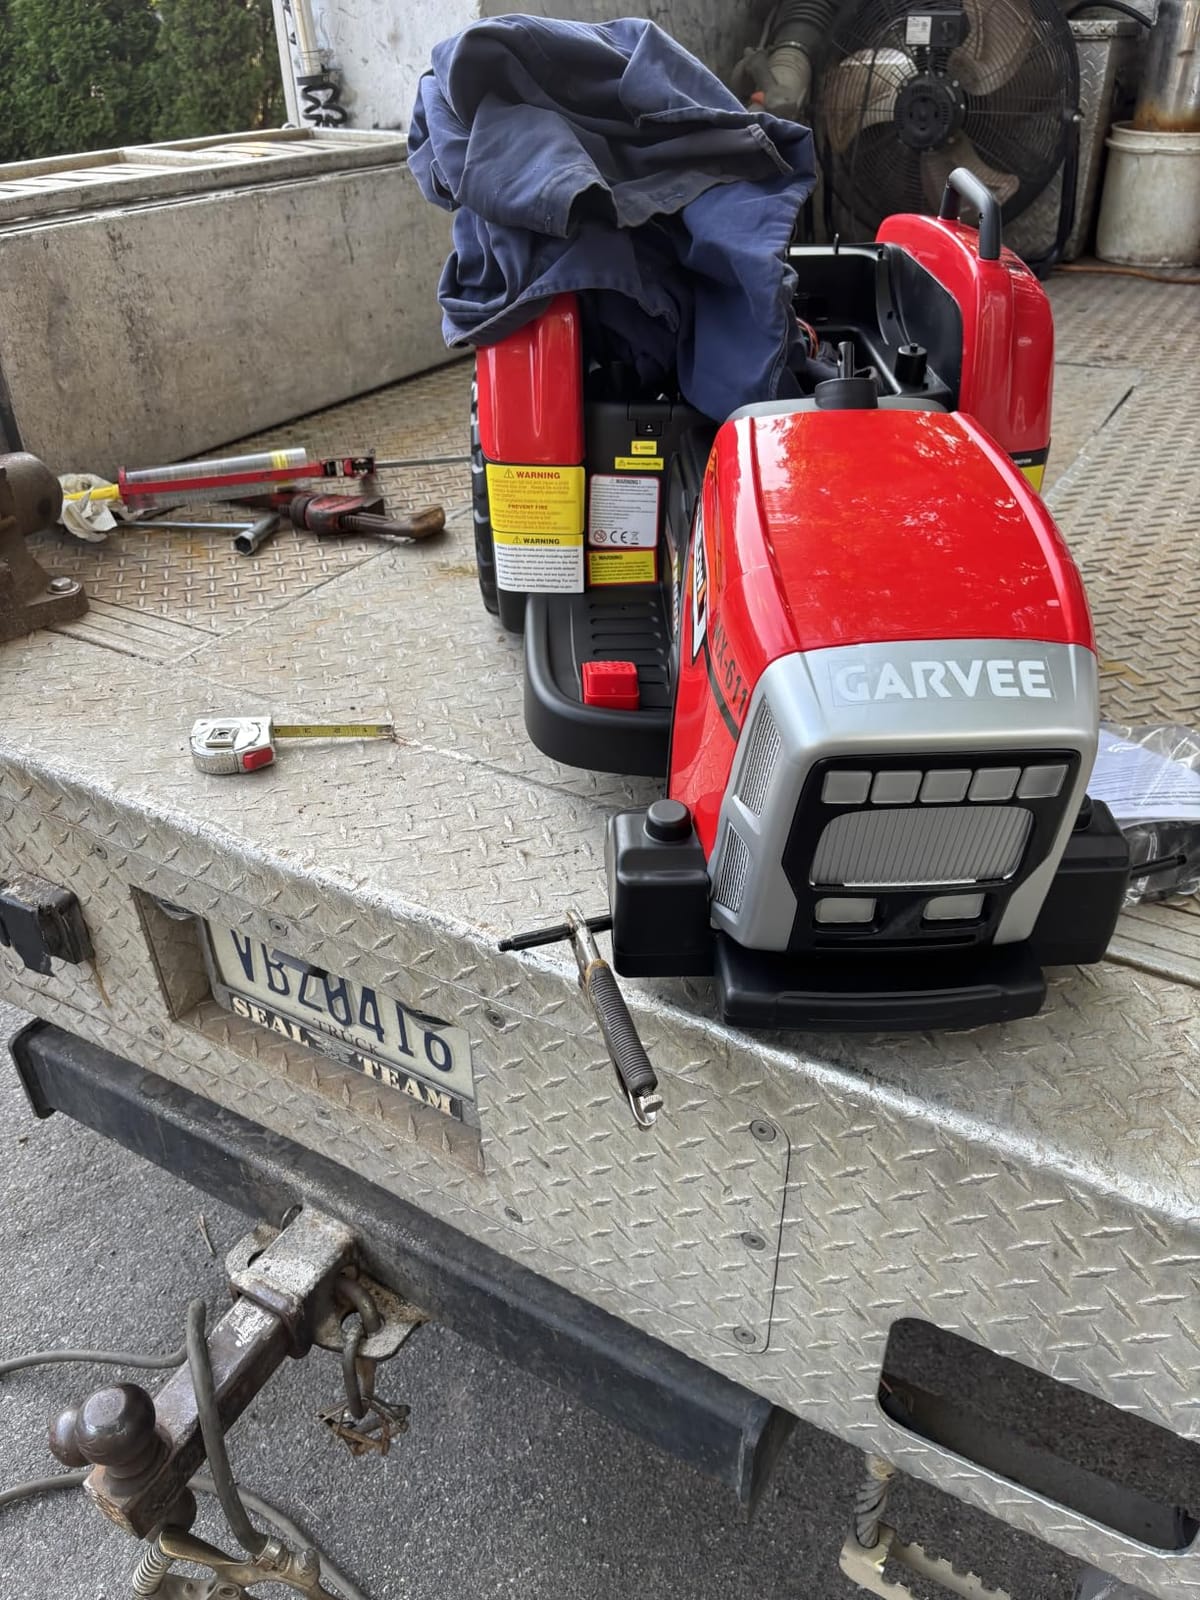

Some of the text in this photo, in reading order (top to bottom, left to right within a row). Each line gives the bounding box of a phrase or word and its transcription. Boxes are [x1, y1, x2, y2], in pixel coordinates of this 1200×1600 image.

[516, 471, 561, 480] WARNING
[508, 503, 534, 511] PREVENT
[711, 613, 748, 717] MX-611
[833, 659, 1053, 702] GARVEE
[232, 996, 453, 1116] SEAL TEAM
[312, 1016, 380, 1055] TRUCK
